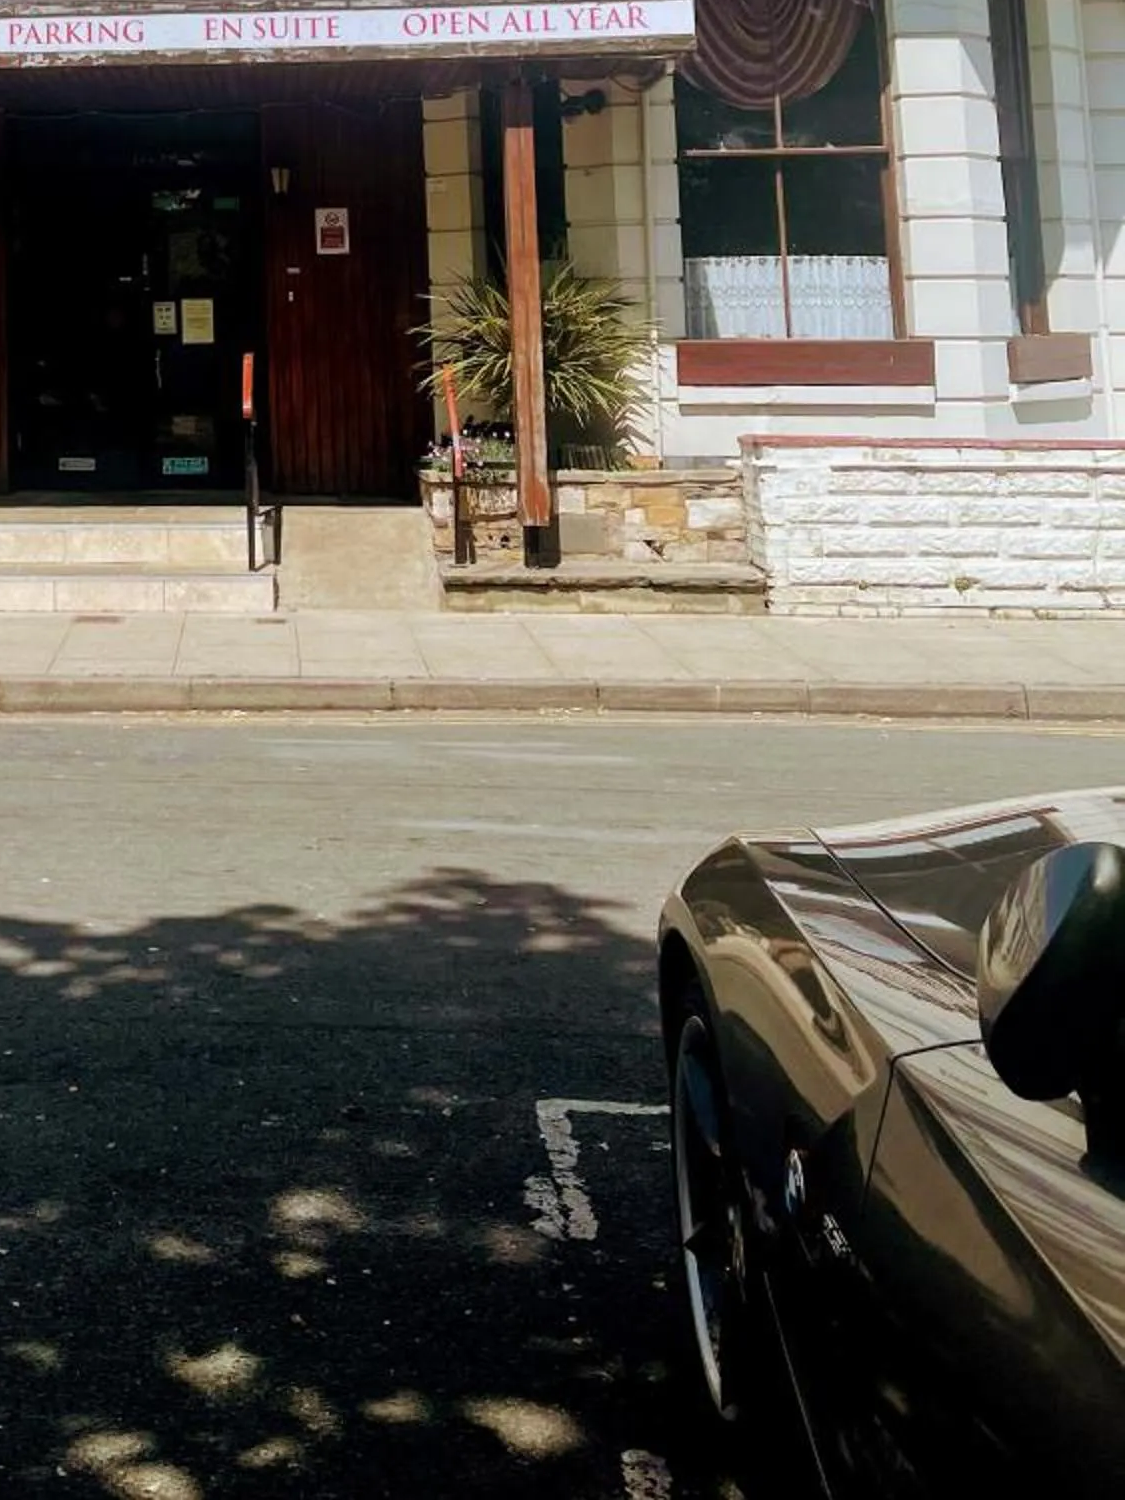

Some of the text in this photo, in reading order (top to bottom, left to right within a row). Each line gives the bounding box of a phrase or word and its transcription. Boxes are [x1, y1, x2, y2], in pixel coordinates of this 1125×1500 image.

[9, 19, 145, 45] PARKING
[205, 15, 340, 41] EN SUITE
[403, 3, 651, 37] OPEN ALL YEAR
